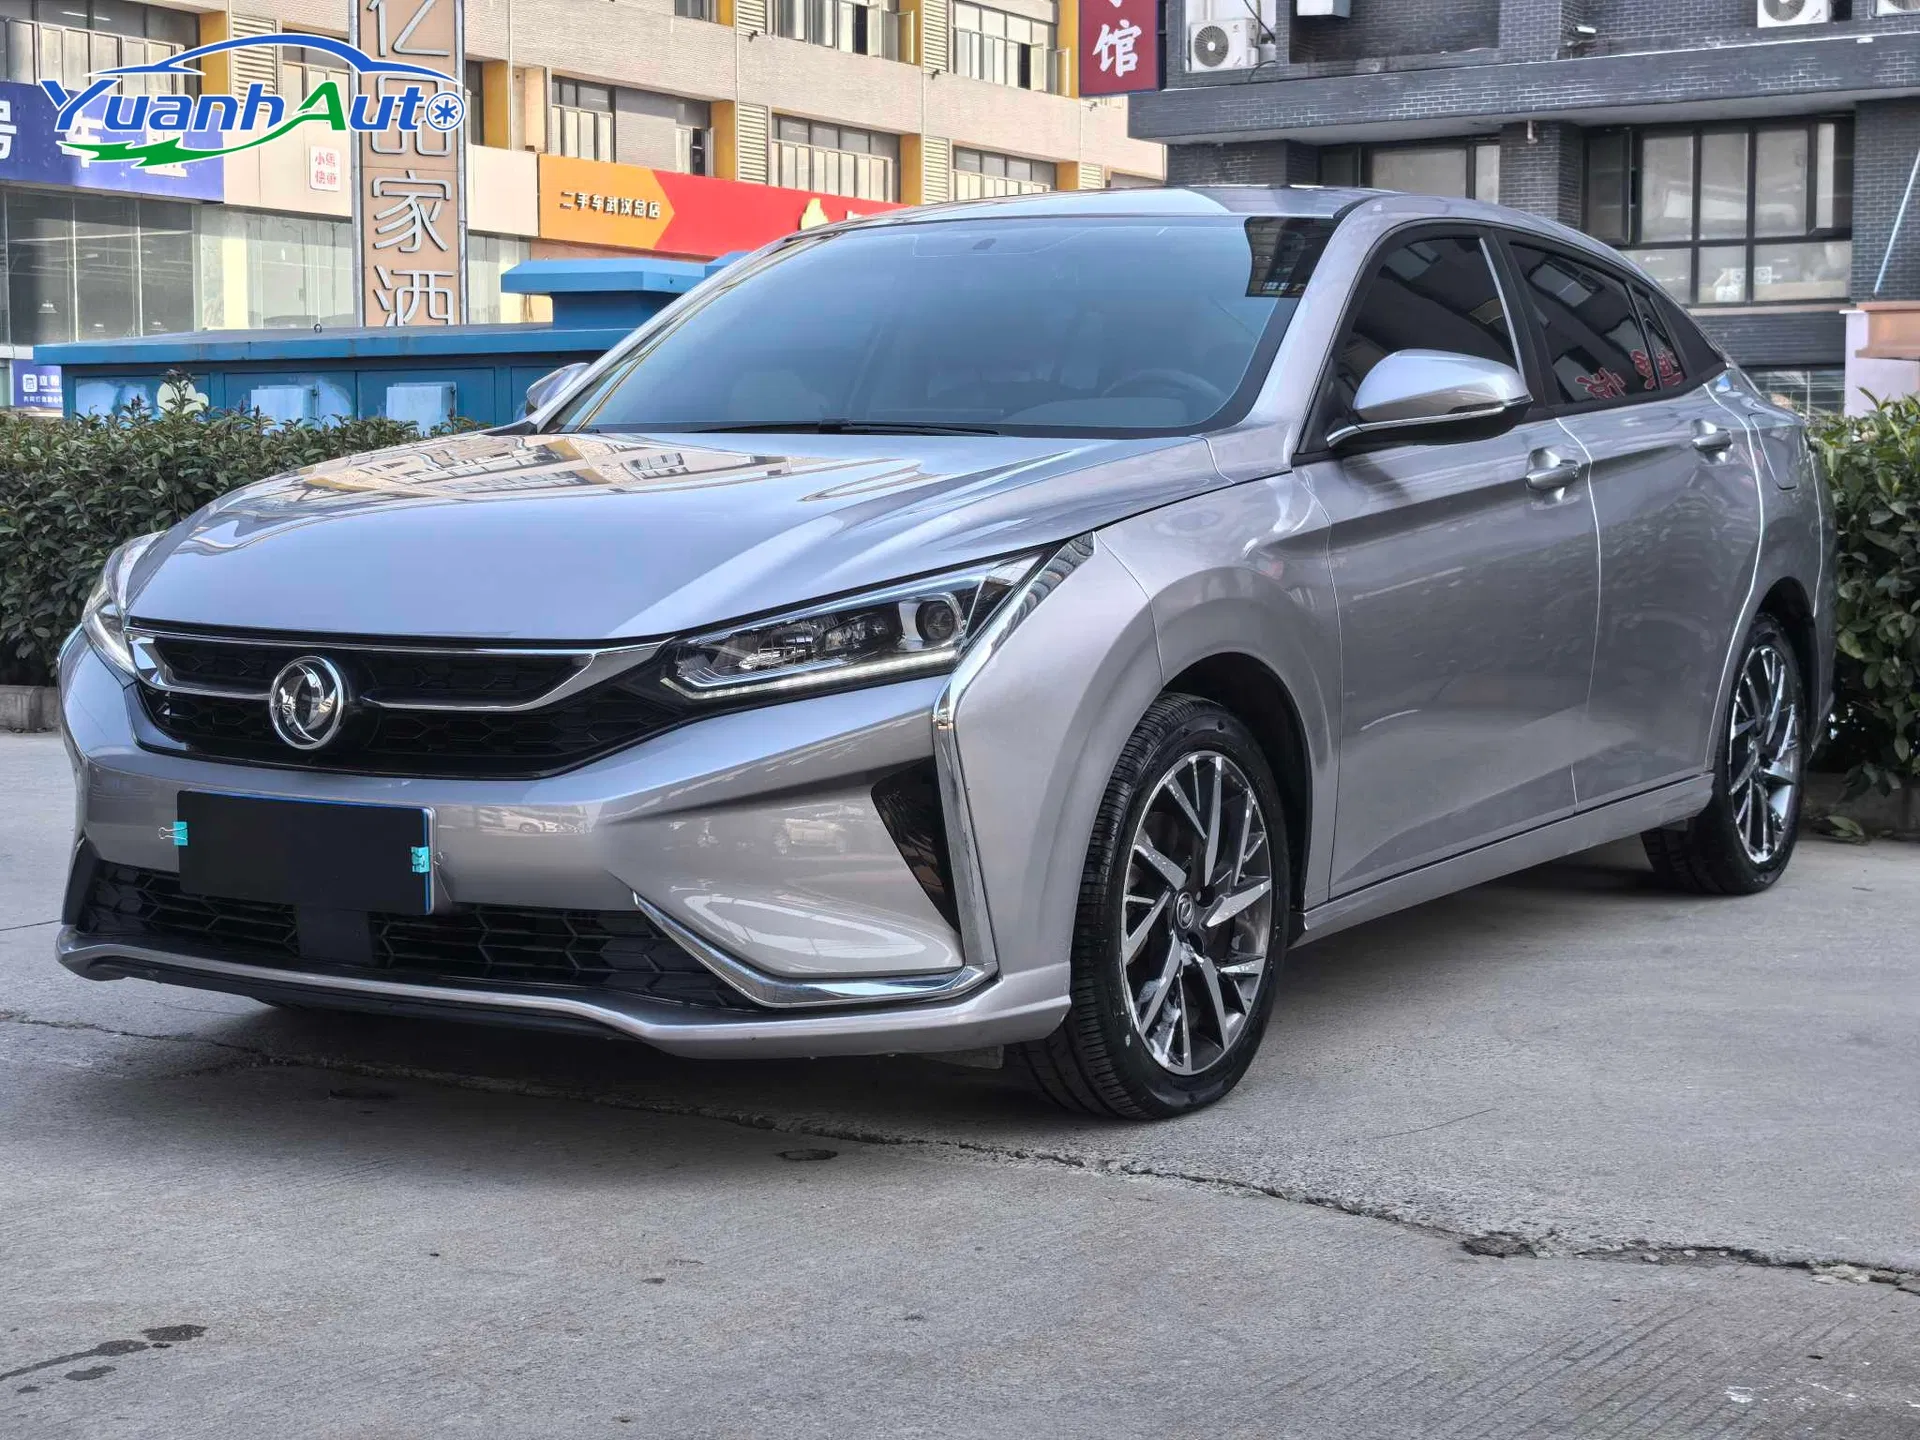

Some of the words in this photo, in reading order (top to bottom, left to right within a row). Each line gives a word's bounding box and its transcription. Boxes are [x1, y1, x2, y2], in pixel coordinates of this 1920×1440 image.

[1092, 0, 1142, 78] 馆
[560, 191, 660, 219] 二手车武汉总店
